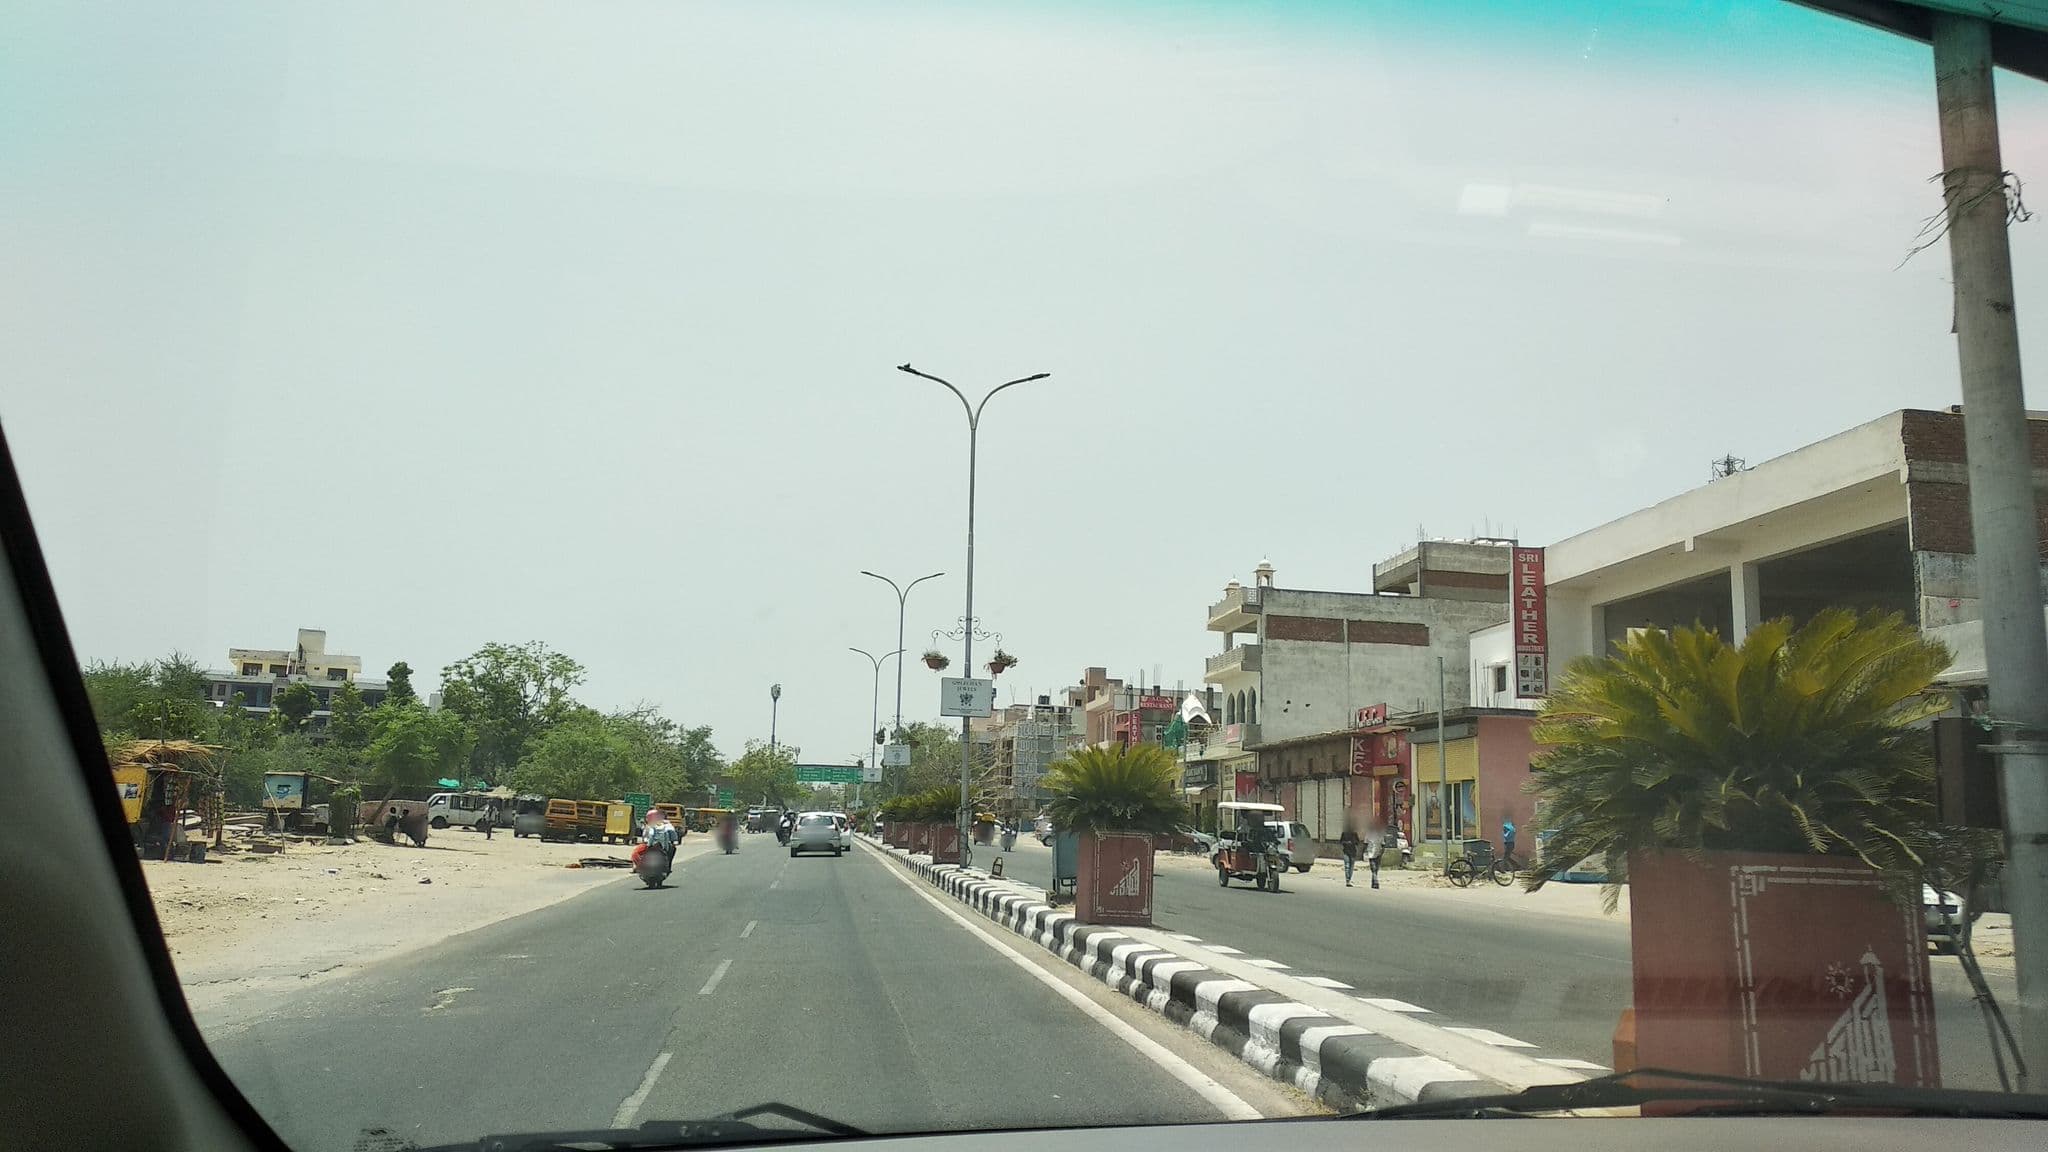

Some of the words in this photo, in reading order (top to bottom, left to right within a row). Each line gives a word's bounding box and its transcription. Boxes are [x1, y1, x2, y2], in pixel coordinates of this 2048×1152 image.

[1519, 553, 1539, 563] SRI
[1521, 564, 1538, 643] LEATHER
[1353, 739, 1365, 774] KFC
